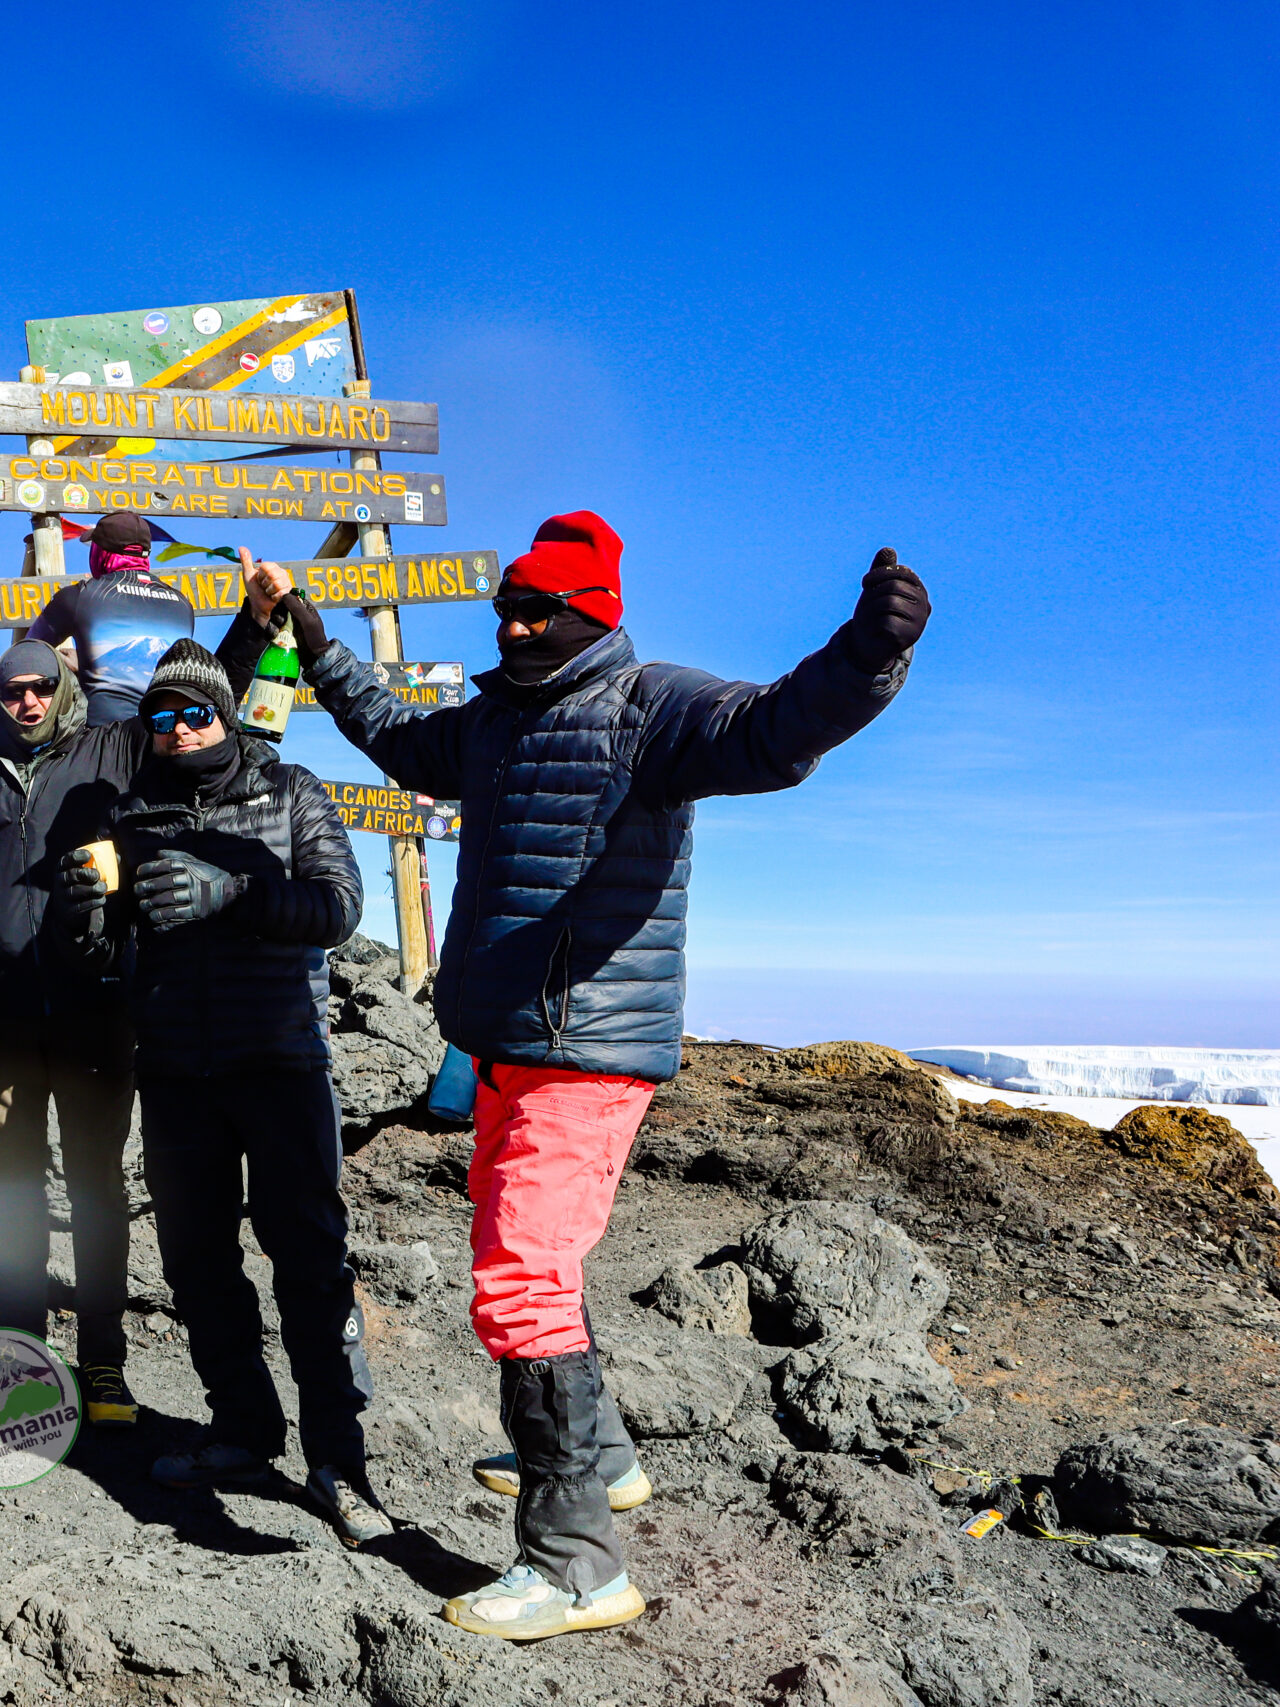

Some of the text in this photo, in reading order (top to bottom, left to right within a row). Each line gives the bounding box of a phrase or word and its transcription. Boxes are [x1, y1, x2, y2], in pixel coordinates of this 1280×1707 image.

[41, 391, 391, 442] MOUNT KILIMANJARO
[9, 458, 407, 496] CONGRATULATIONS
[94, 489, 352, 518] YOU ARE NOW AT
[116, 583, 179, 601] KiliMania
[306, 561, 398, 602] 5895M
[407, 559, 475, 598] AMSL
[322, 783, 412, 810] LCANOES
[338, 807, 360, 826] OF
[363, 810, 425, 834] AFRICA
